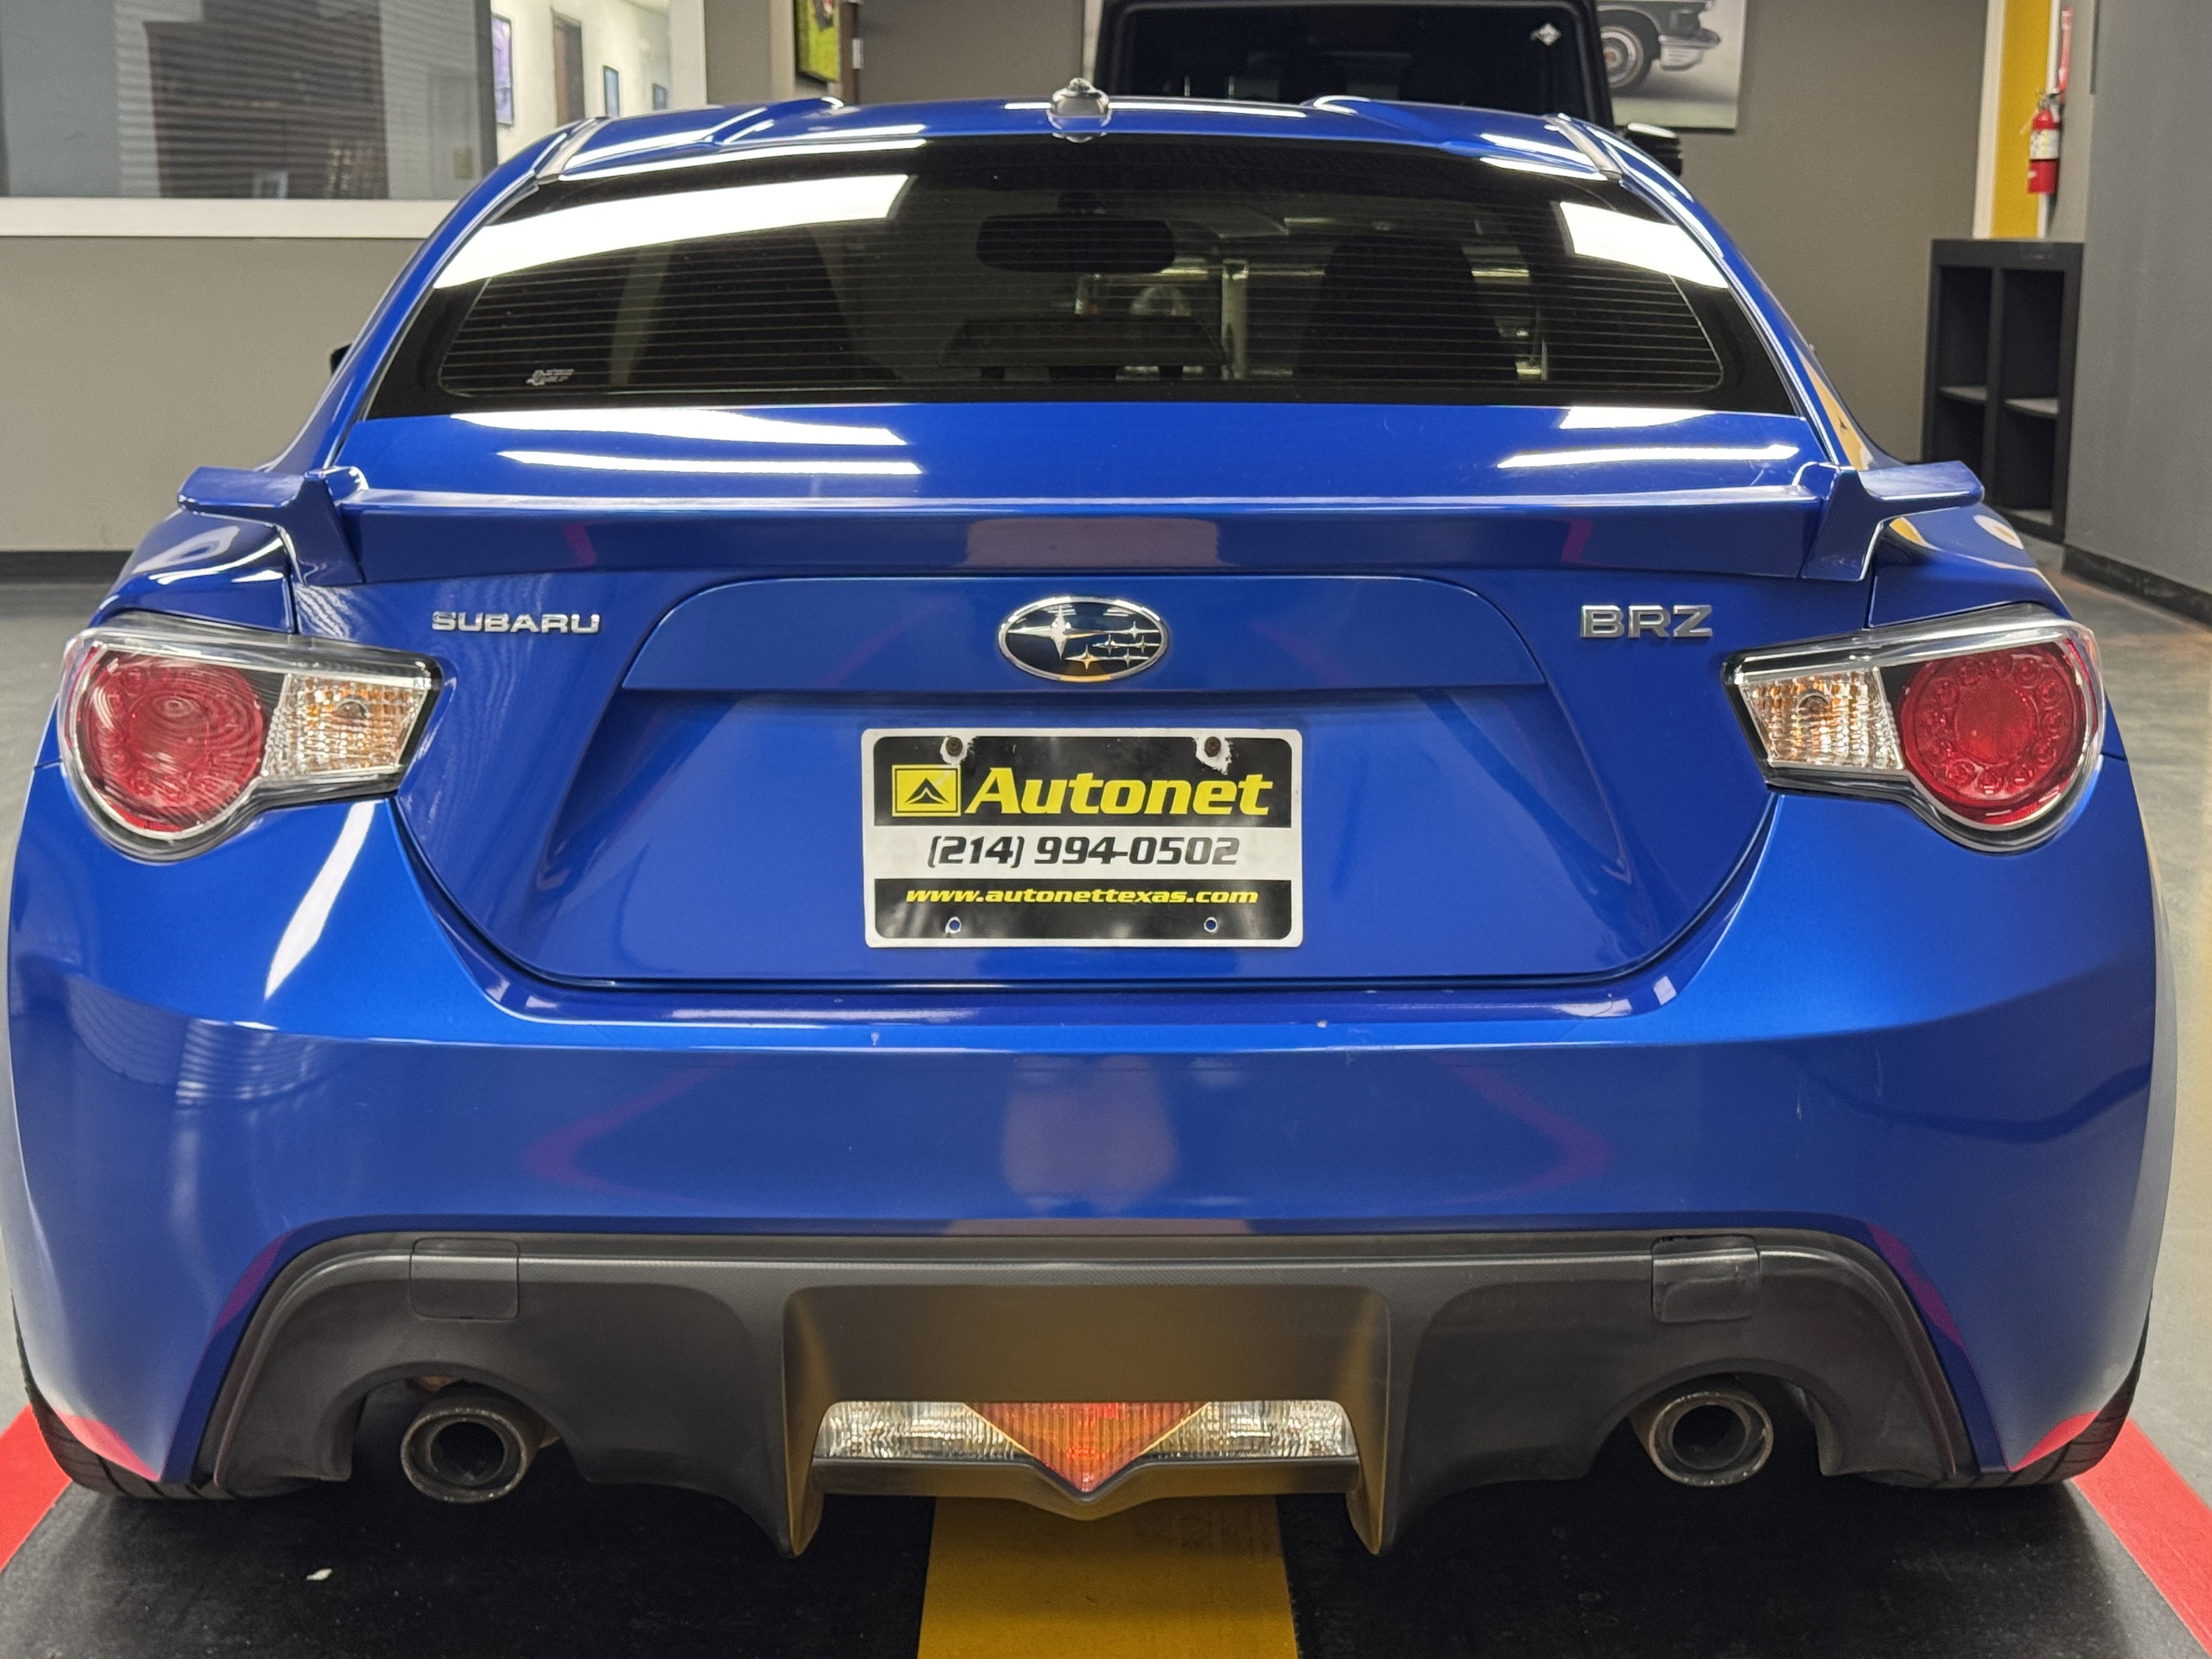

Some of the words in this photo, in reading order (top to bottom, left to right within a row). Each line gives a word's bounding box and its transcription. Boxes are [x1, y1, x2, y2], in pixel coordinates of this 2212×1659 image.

[432, 611, 601, 633] SUBARU
[1580, 604, 1713, 637] BRZ
[964, 768, 1273, 815] Autonet
[928, 836, 1024, 868] (214)
[1035, 837, 1240, 866] 994-0502
[906, 889, 1259, 904] www.autonettexas.com
